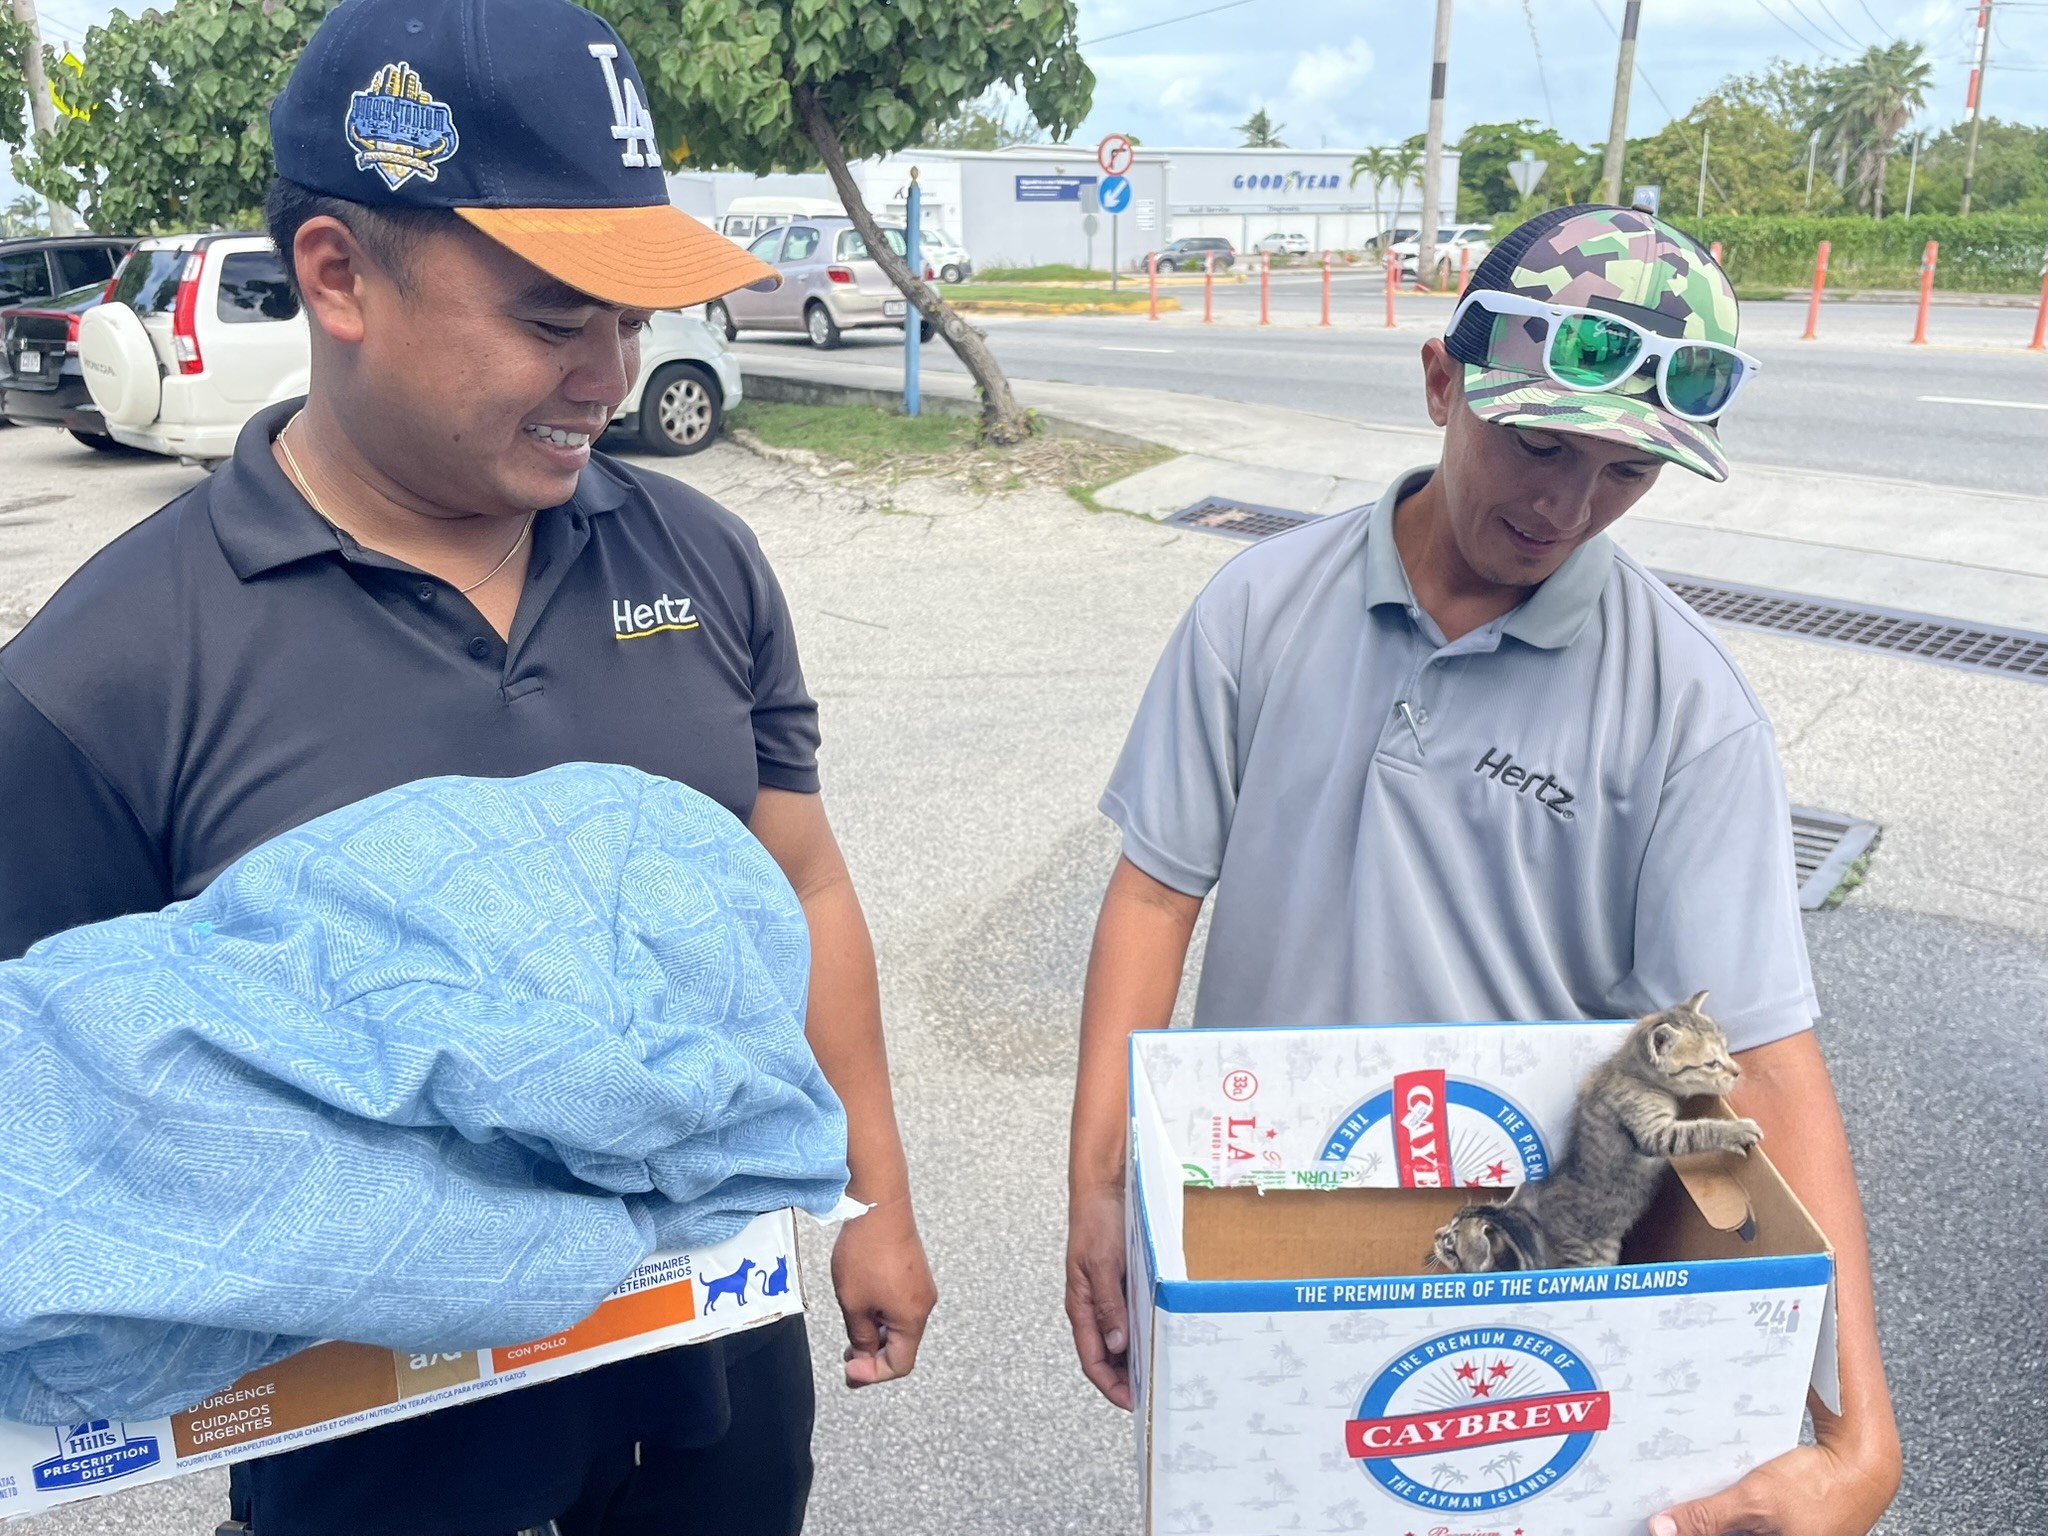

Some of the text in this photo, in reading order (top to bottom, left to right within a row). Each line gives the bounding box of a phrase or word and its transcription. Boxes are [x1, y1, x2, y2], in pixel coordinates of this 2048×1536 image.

[392, 98, 445, 134] STADIUM
[588, 44, 662, 167] LA
[612, 593, 697, 632] Hertz
[1473, 747, 1575, 815] Hertz
[1340, 1111, 1370, 1140] THE
[1496, 1105, 1526, 1134] THE
[1294, 1269, 1690, 1304] THE PREMIUM BEER OF THE CAYMAN ISLANDS
[507, 1337, 567, 1360] CON POLLO
[1390, 1331, 1576, 1378] THE PREMIUM BEER OF
[176, 1451, 223, 1470] NOURRITURE
[283, 1430, 304, 1443] POUR
[304, 1423, 328, 1437] CHATS
[328, 1420, 339, 1432] ET
[338, 1414, 365, 1428] CHIENS
[453, 1385, 472, 1397] PARA
[472, 1377, 498, 1393] PERROS
[504, 1370, 527, 1382] GATOS
[190, 1404, 271, 1433] CUIDADOS
[192, 1416, 273, 1446] URGENTES
[1361, 1400, 1598, 1449] CAYBREW
[69, 1432, 117, 1455] Hill's
[42, 1445, 149, 1479] PRESCRIPTION
[81, 1463, 115, 1481] DIET
[1386, 1466, 1559, 1509] THE CAYMAN ISLANDS
